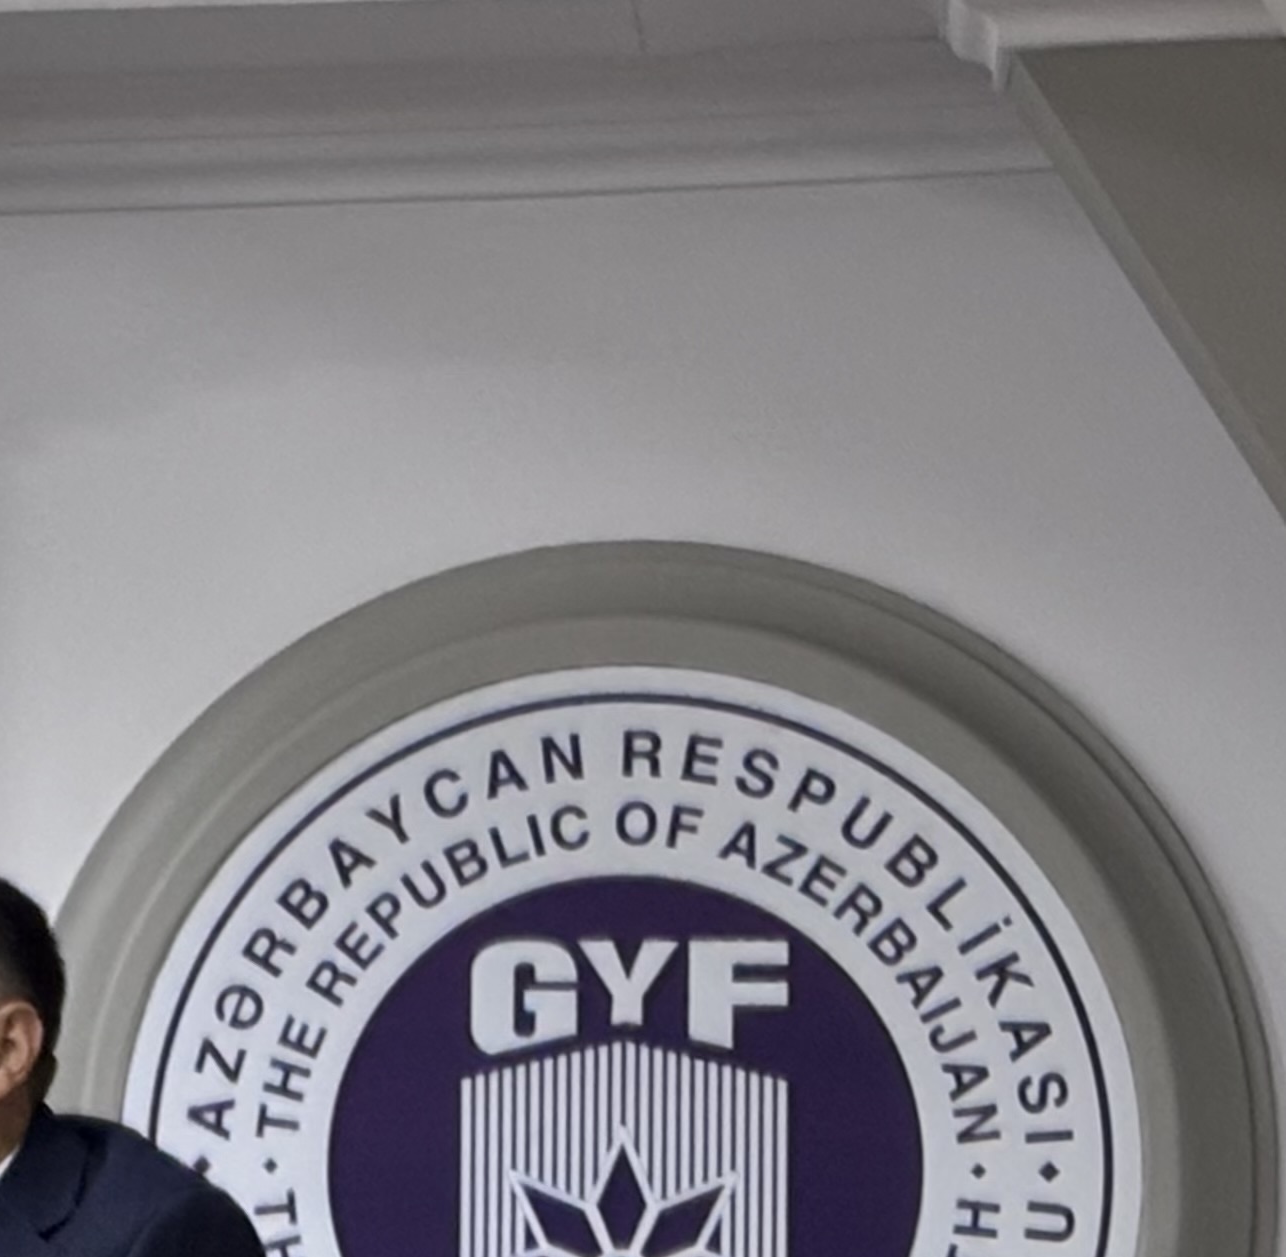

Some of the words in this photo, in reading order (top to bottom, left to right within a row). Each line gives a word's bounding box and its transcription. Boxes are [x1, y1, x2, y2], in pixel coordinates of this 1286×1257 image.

[187, 732, 584, 1140] AZƏRBAYCAN
[621, 728, 1074, 1144] RESPUBLİKASI
[256, 1015, 327, 1138] THE
[306, 804, 590, 1007] REPUBLIC
[615, 800, 705, 849] OF
[717, 820, 1002, 1145] AZERBAIJAN
[468, 936, 790, 1056] GYF
